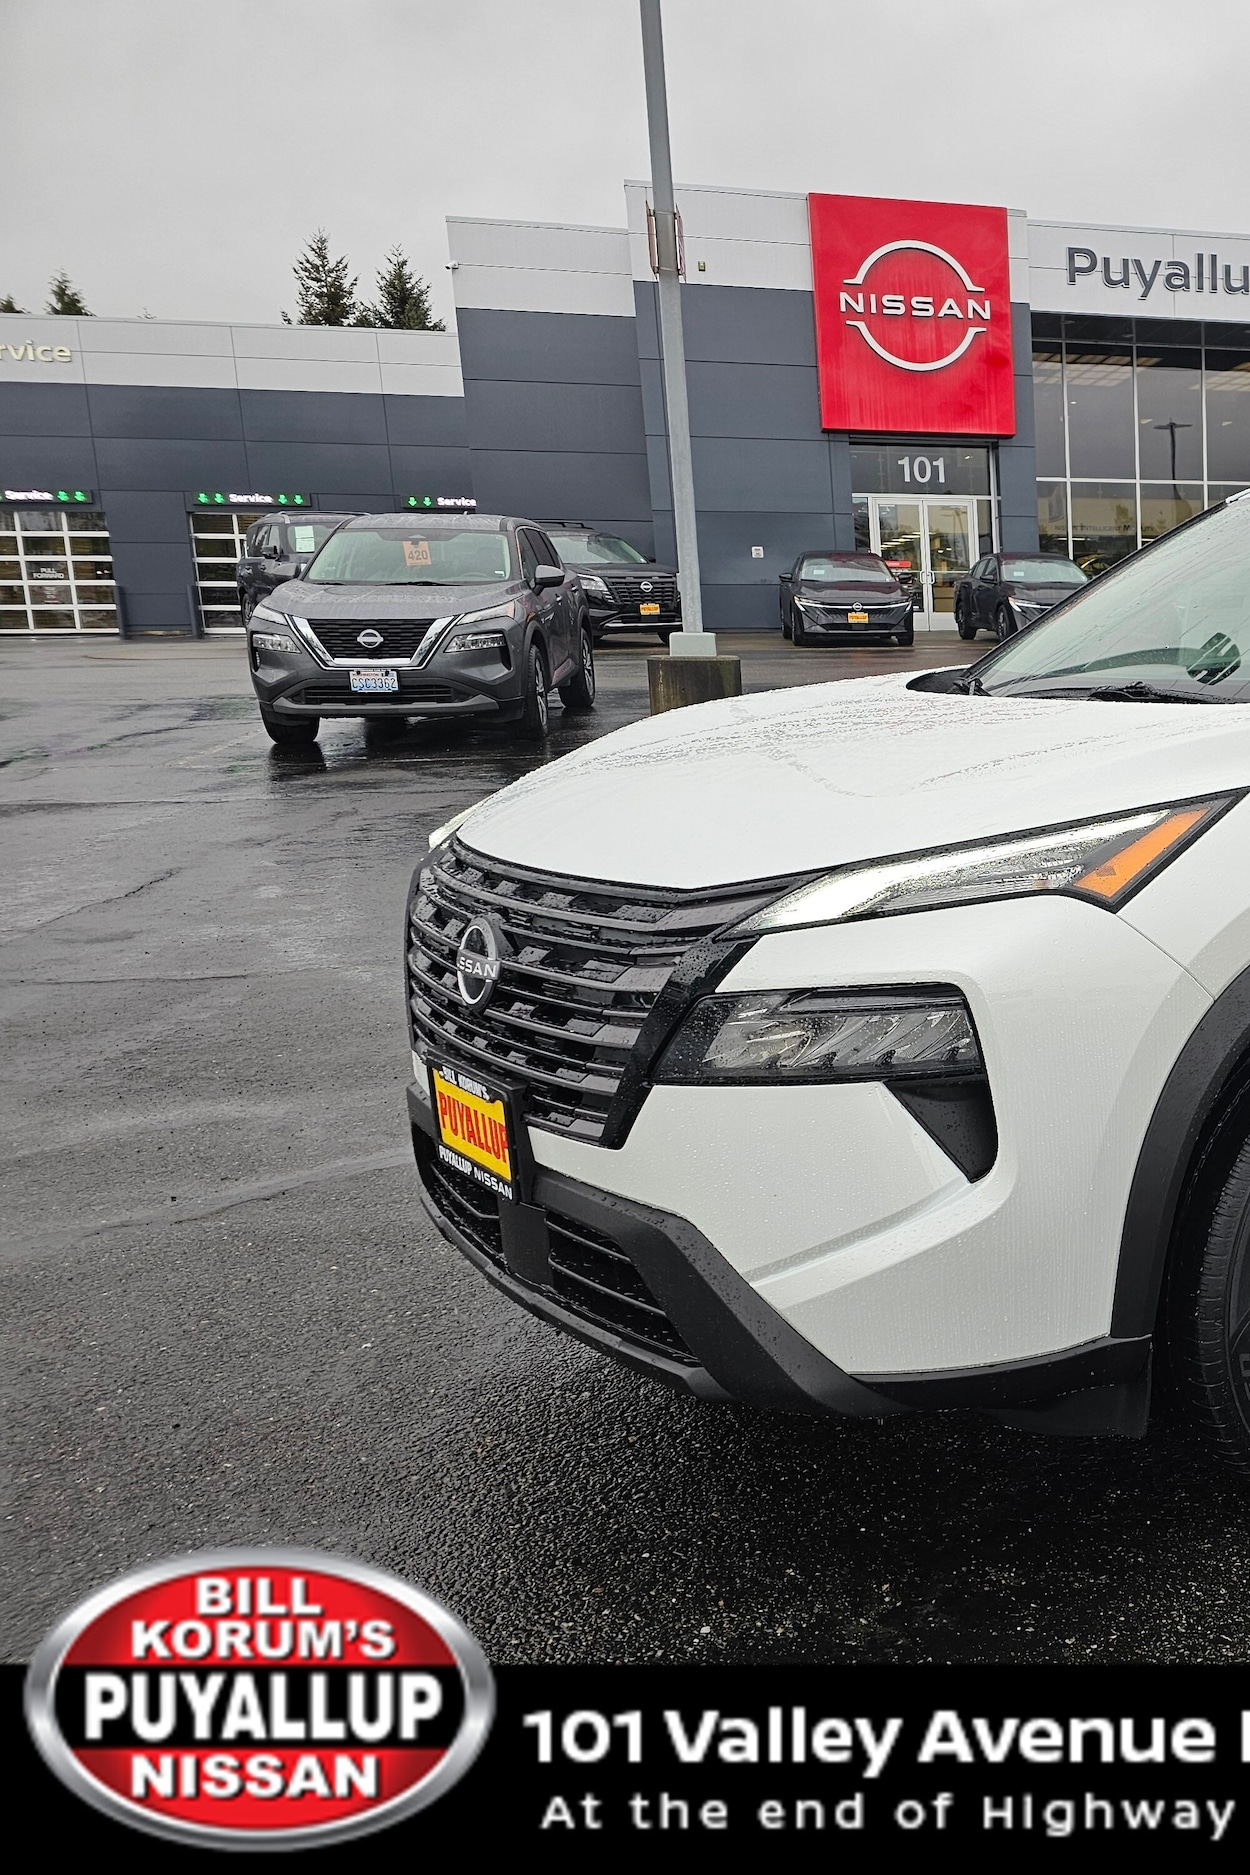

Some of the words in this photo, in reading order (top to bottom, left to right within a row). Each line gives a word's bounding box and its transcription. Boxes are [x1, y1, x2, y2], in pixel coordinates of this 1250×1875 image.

[839, 291, 991, 320] NISSAN
[897, 456, 945, 483] 101
[228, 492, 273, 504] Service
[436, 496, 477, 507] Service
[408, 549, 428, 560] 420
[438, 1090, 509, 1163] PUYALLUP
[438, 1144, 473, 1176] PUYALLUP
[473, 1166, 513, 1201] NISSAN
